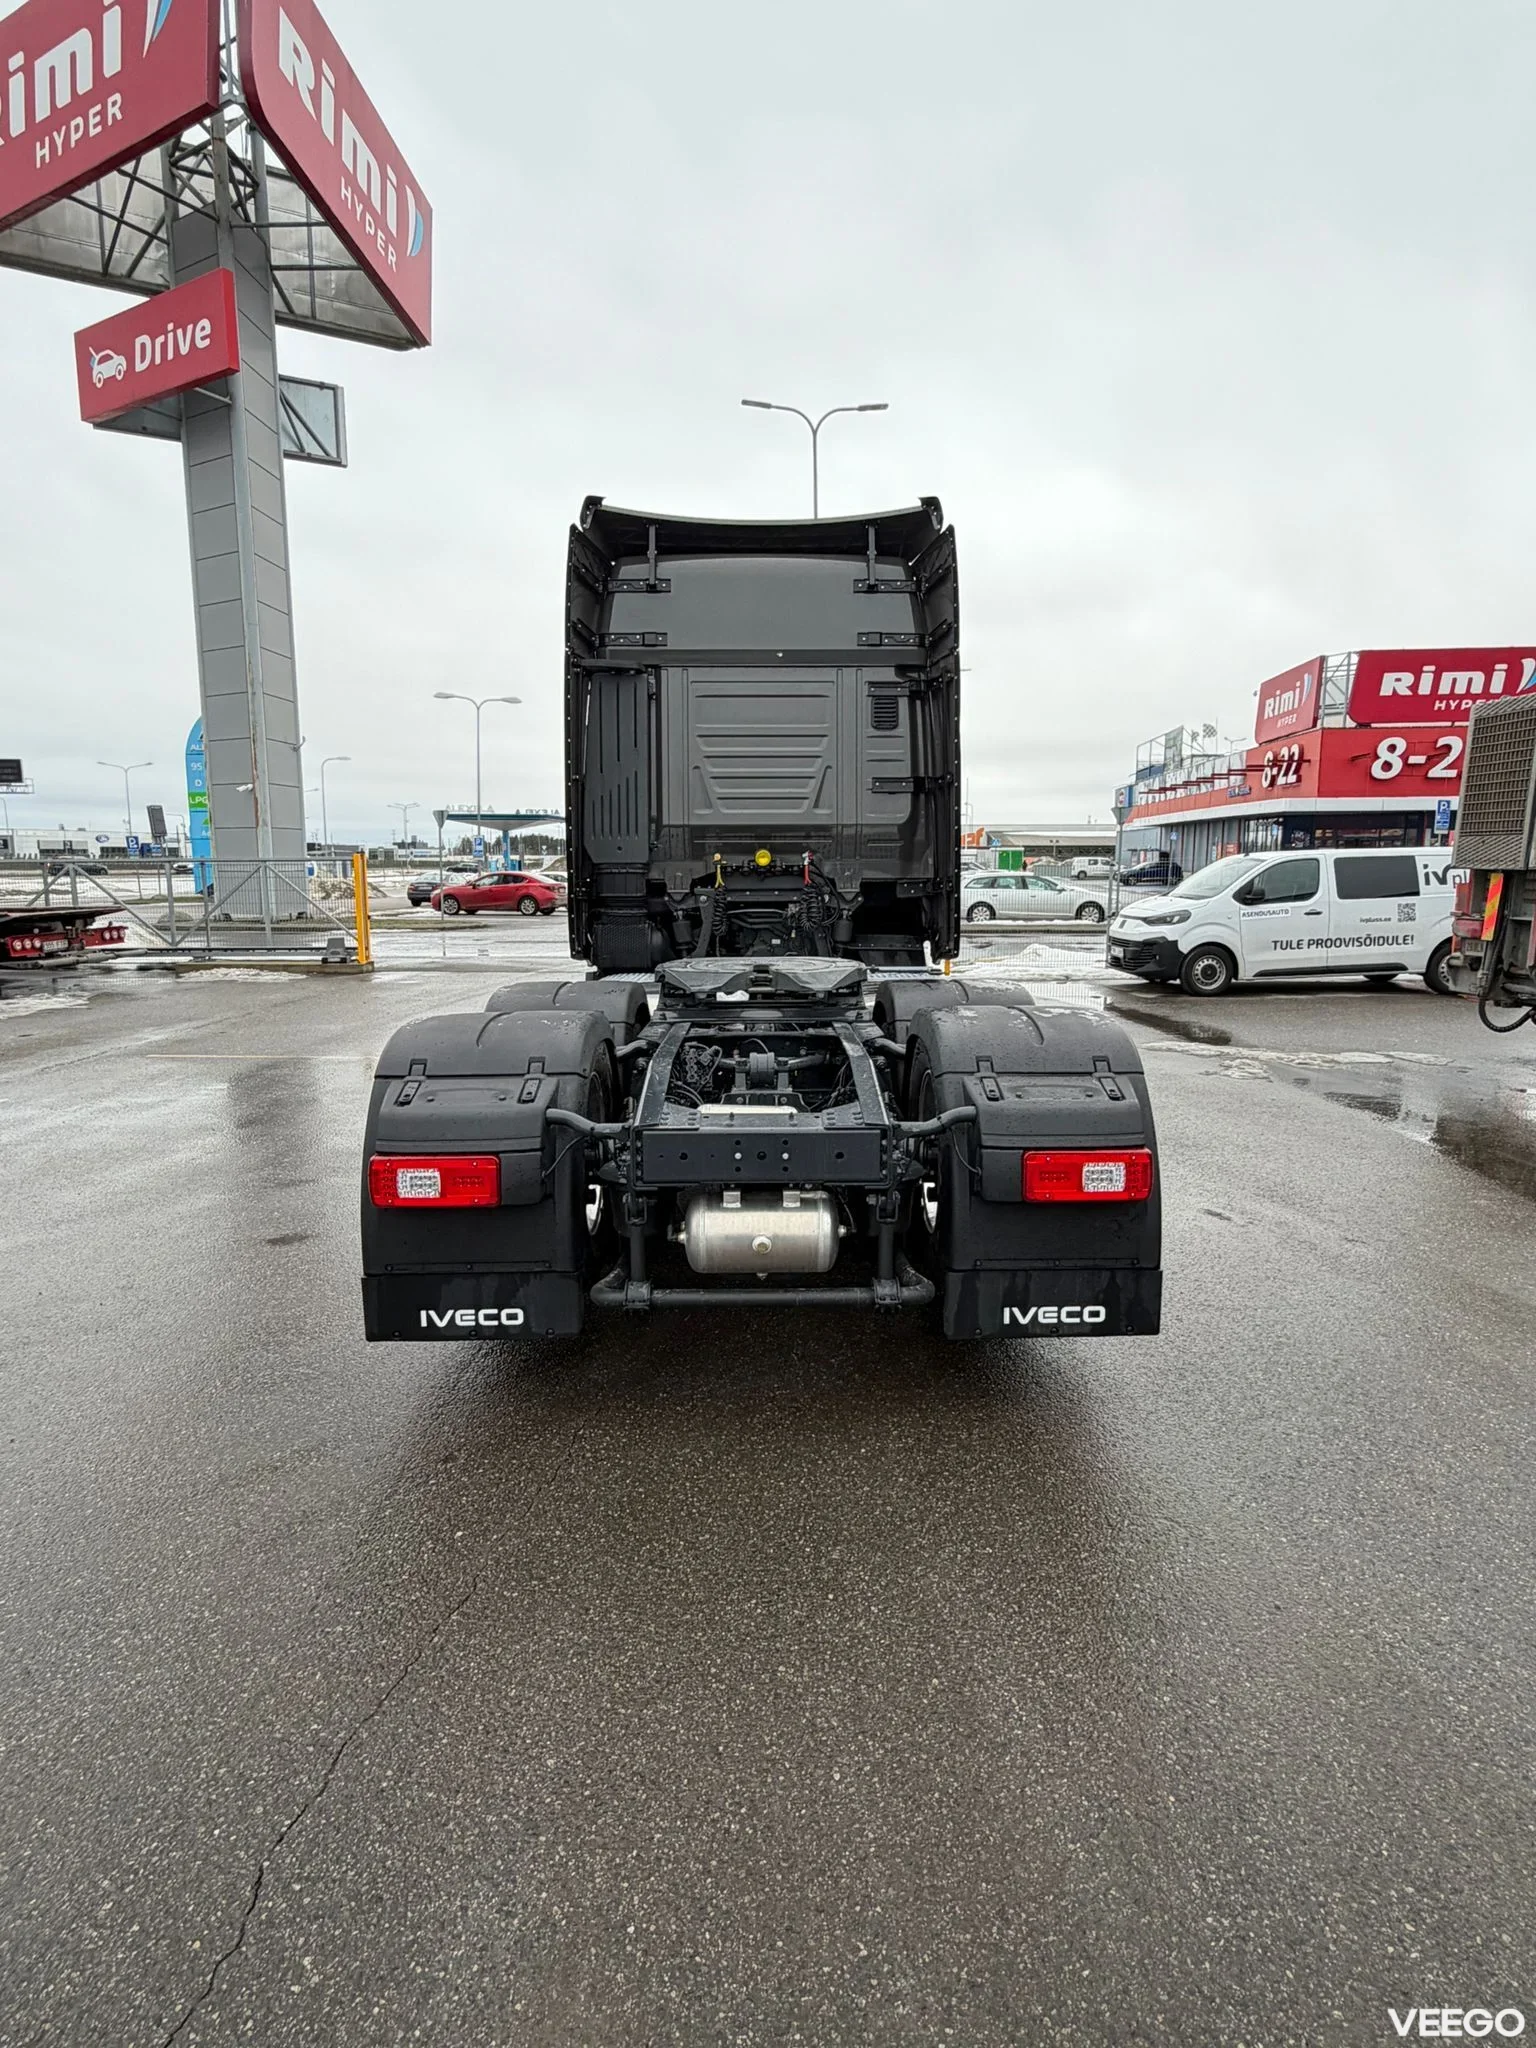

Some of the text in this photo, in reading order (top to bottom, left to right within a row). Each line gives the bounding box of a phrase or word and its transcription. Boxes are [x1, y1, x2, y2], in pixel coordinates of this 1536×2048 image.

[0, 0, 122, 146] imi
[35, 92, 123, 170] HYPER
[278, 6, 397, 239] Rimi
[340, 176, 397, 273] HYPER
[134, 318, 212, 373] Drive
[1378, 663, 1509, 697] Rimi
[1263, 680, 1301, 720] Rimi
[1433, 699, 1497, 711] HYP
[1370, 736, 1464, 780] 8-2
[1422, 863, 1468, 889] ivpl
[1241, 908, 1290, 919] ASENDUSAUTO
[1271, 933, 1415, 952] TULE PROOVISÕIDULE!
[420, 1308, 524, 1328] IVECO
[1003, 1305, 1106, 1325] IVECO
